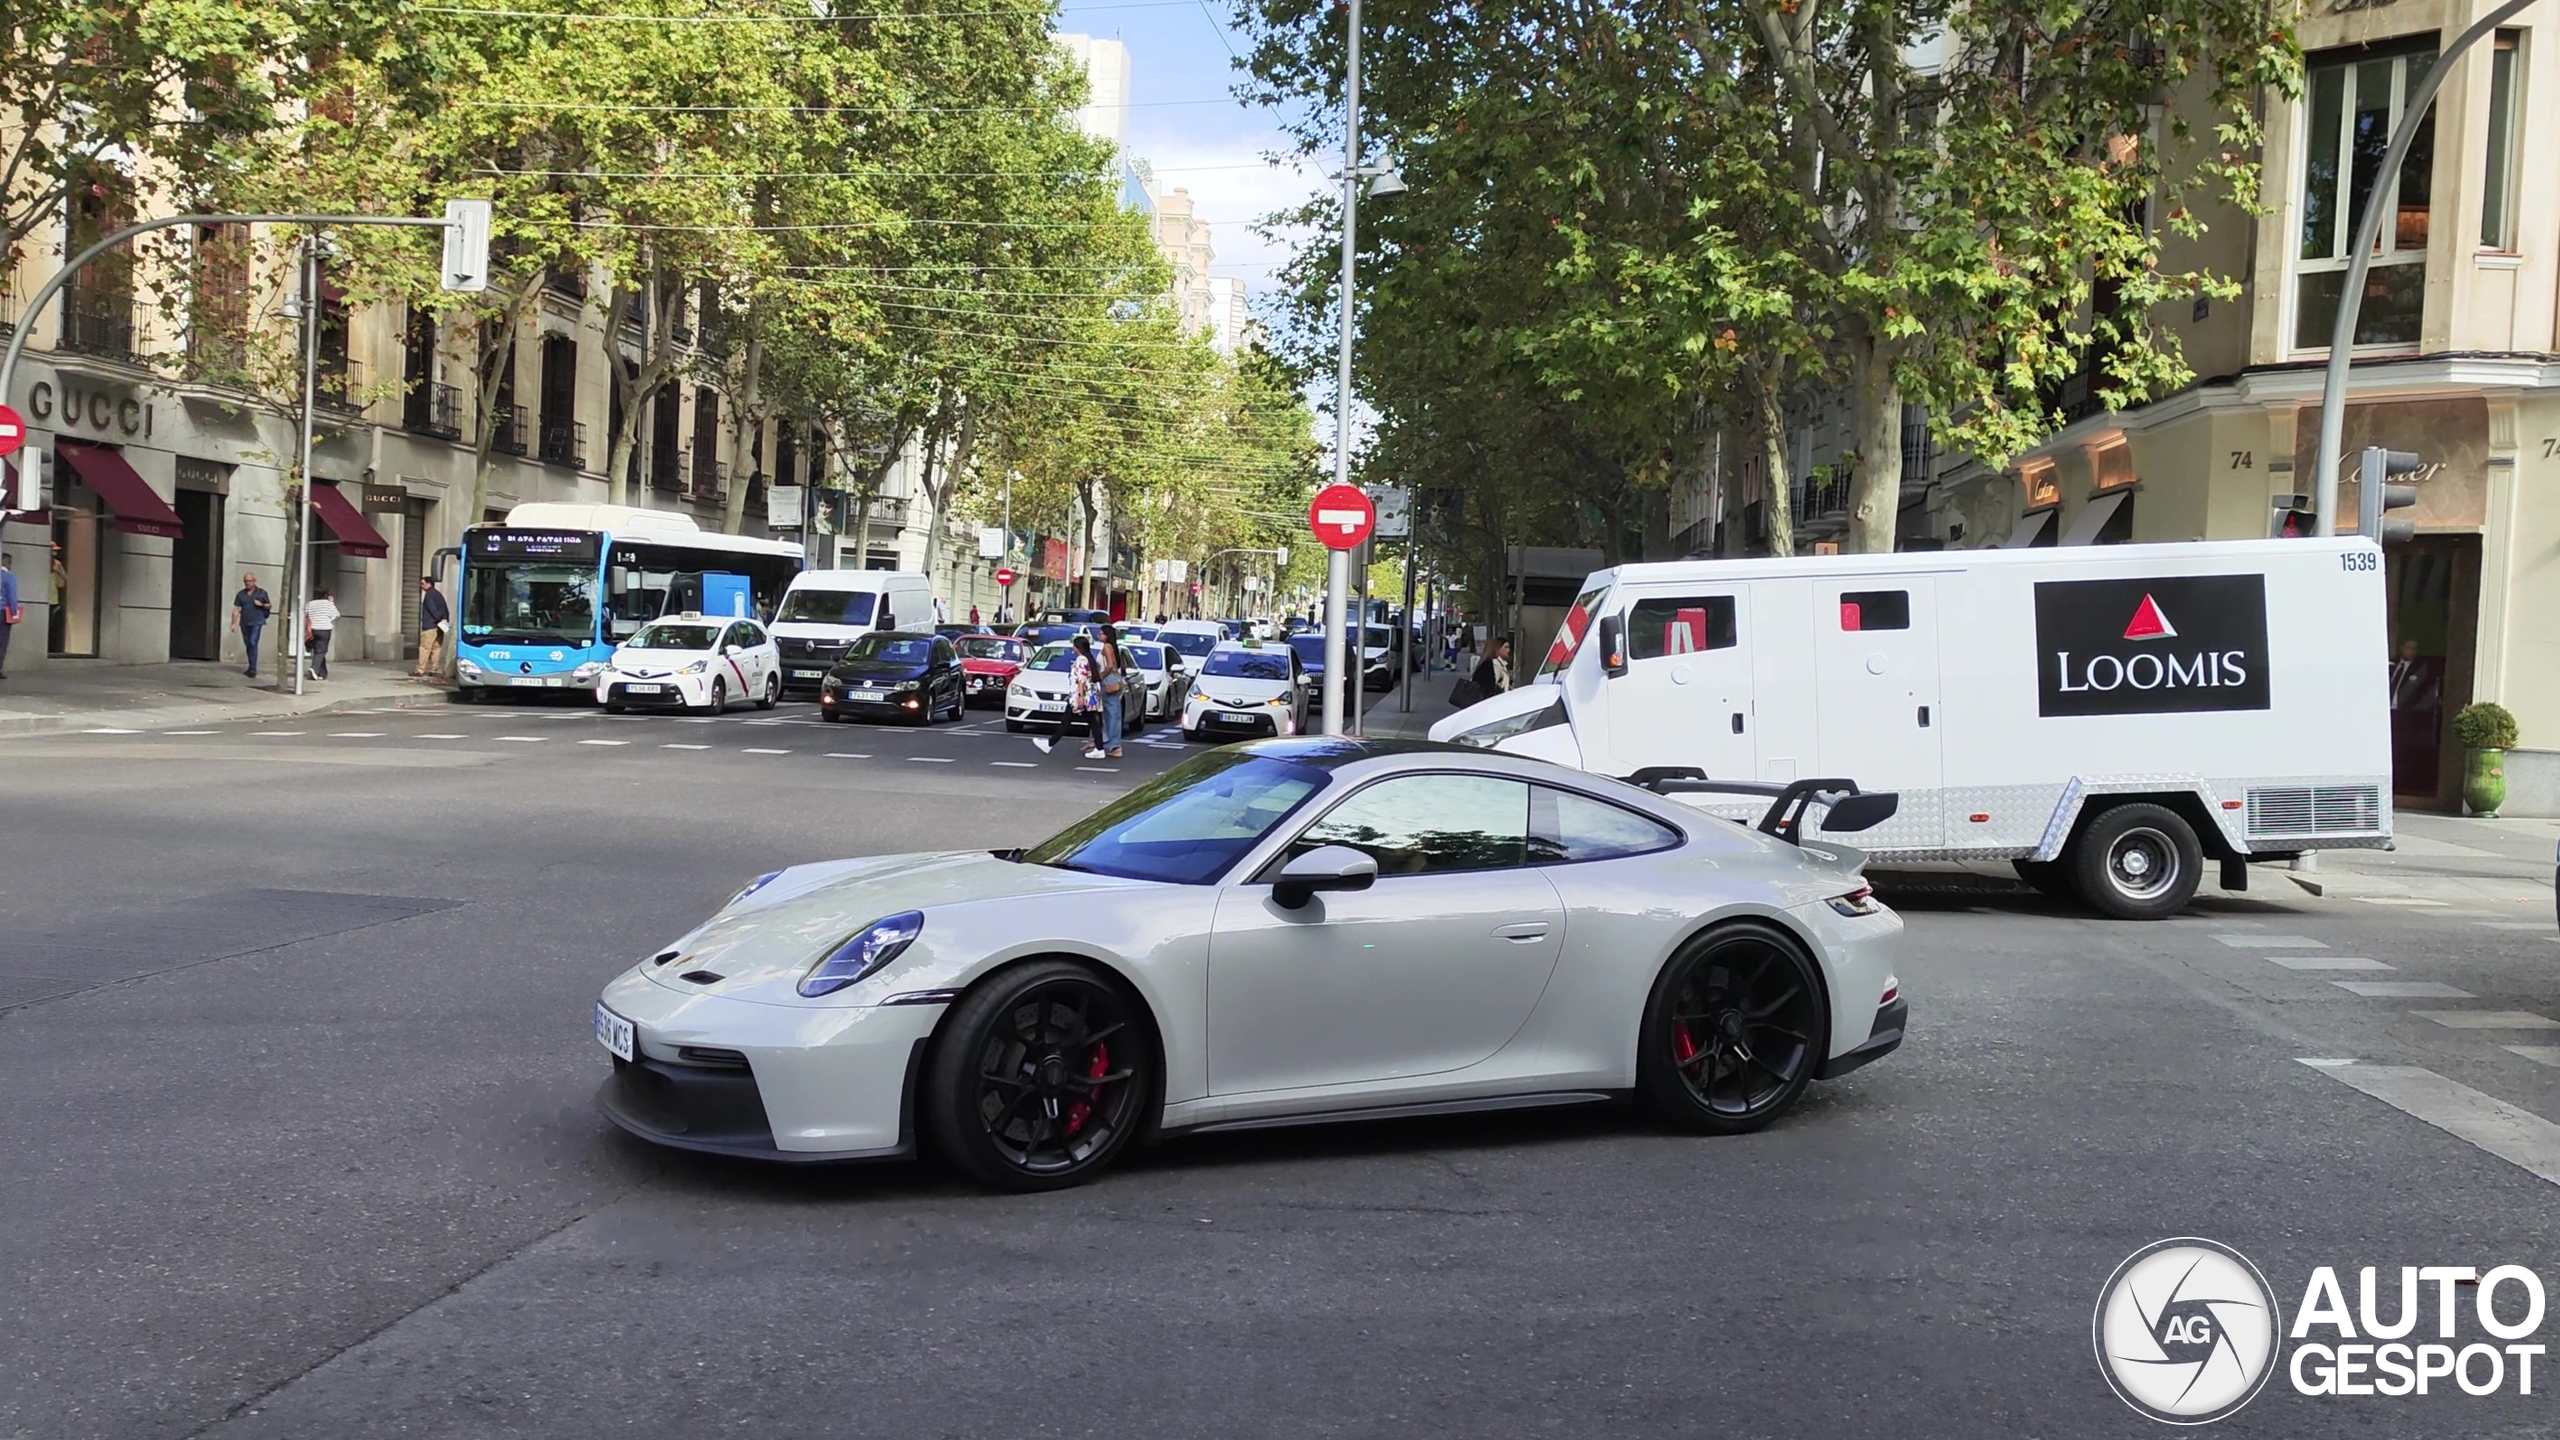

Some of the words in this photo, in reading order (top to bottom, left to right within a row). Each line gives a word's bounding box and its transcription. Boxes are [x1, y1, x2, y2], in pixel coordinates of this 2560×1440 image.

[29, 381, 153, 438] GUCCI
[2231, 450, 2253, 469] 74
[178, 467, 218, 485] GUCCI
[365, 494, 401, 503] GUCCI
[2340, 552, 2377, 571] 1539
[489, 651, 510, 659] 4775
[2057, 650, 2247, 692] LOOMIS
